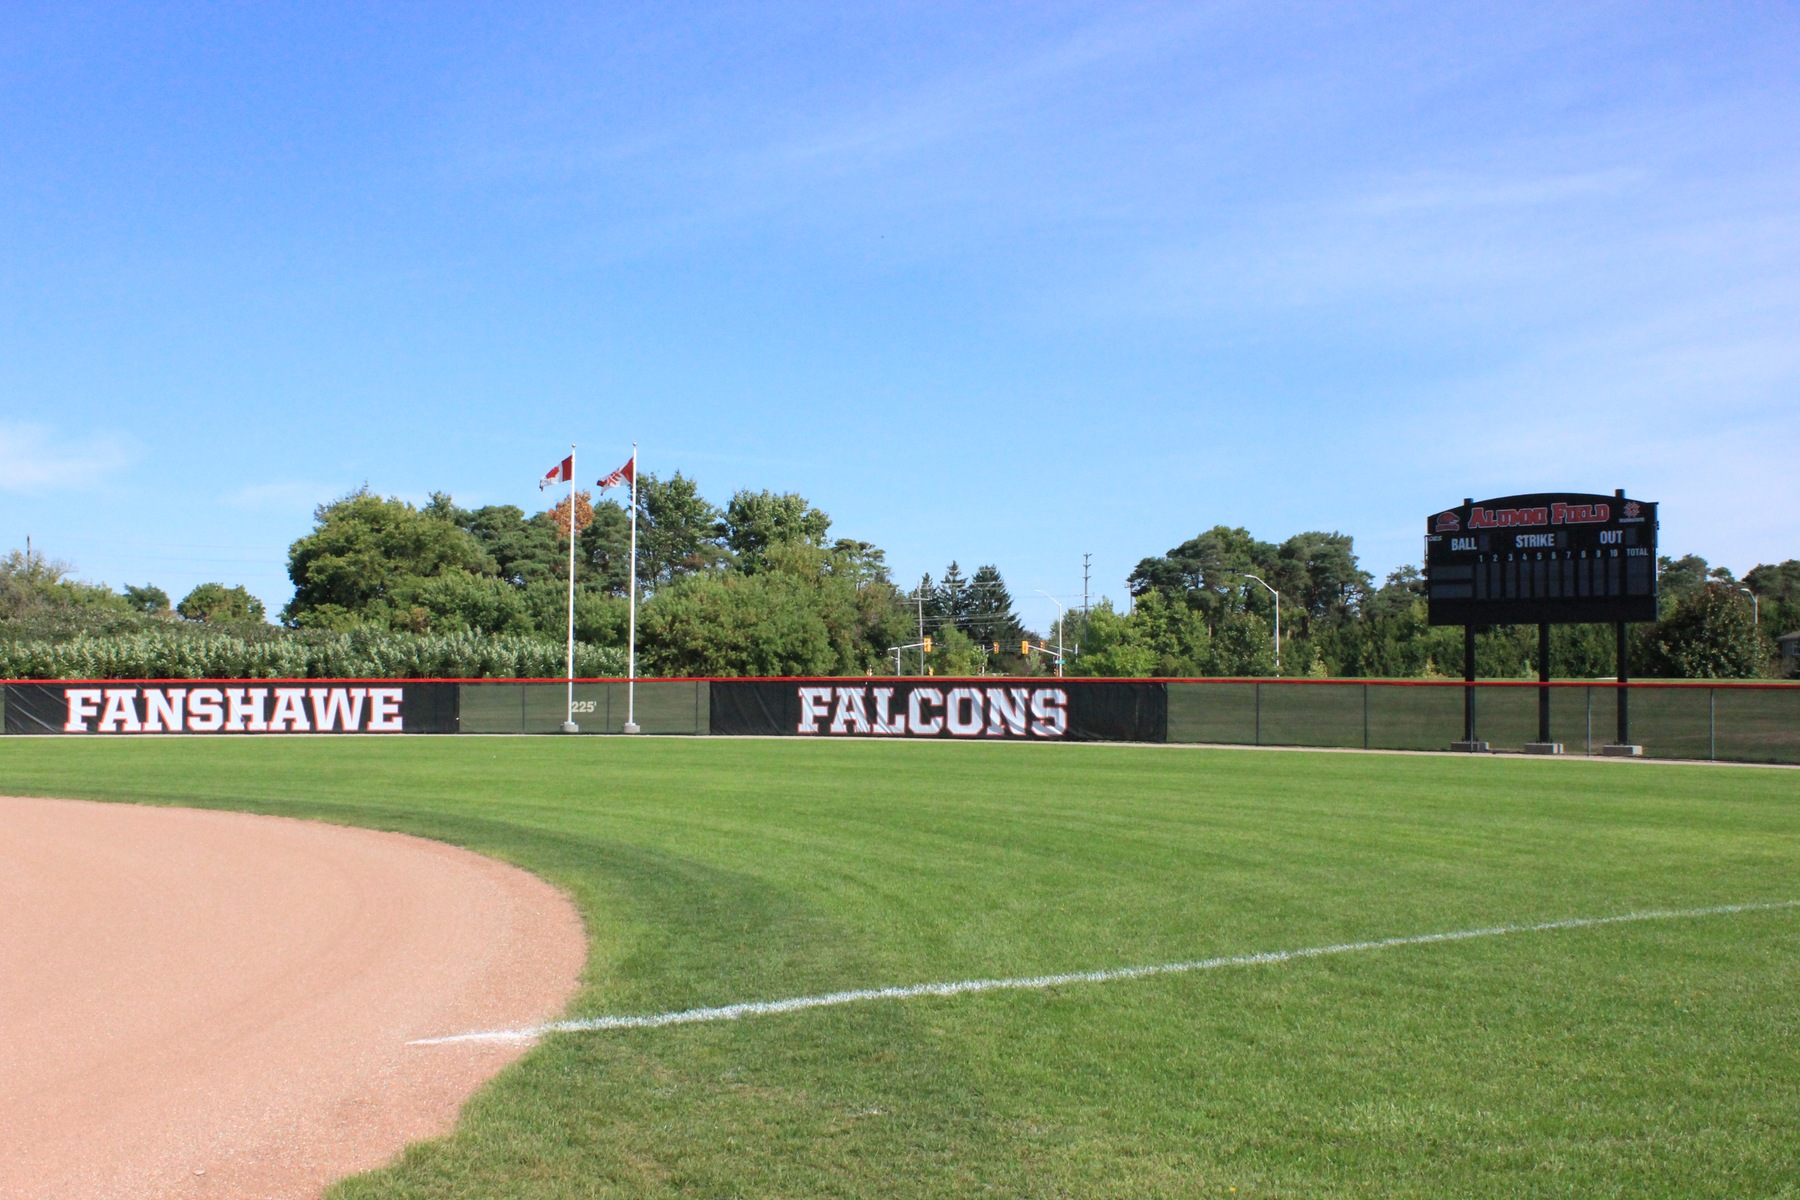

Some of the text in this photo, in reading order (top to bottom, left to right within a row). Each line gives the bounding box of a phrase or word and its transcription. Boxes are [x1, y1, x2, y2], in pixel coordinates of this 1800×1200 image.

[1467, 502, 1610, 529] ALUMNI FIELD
[1451, 530, 1623, 551] BALL STRIKE OUT
[1479, 548, 1648, 562] 1 2 3 4 5 6 7 8 9 10 TOTAL
[64, 687, 404, 732] FANSHAWE
[797, 685, 1069, 737] FALCONS
